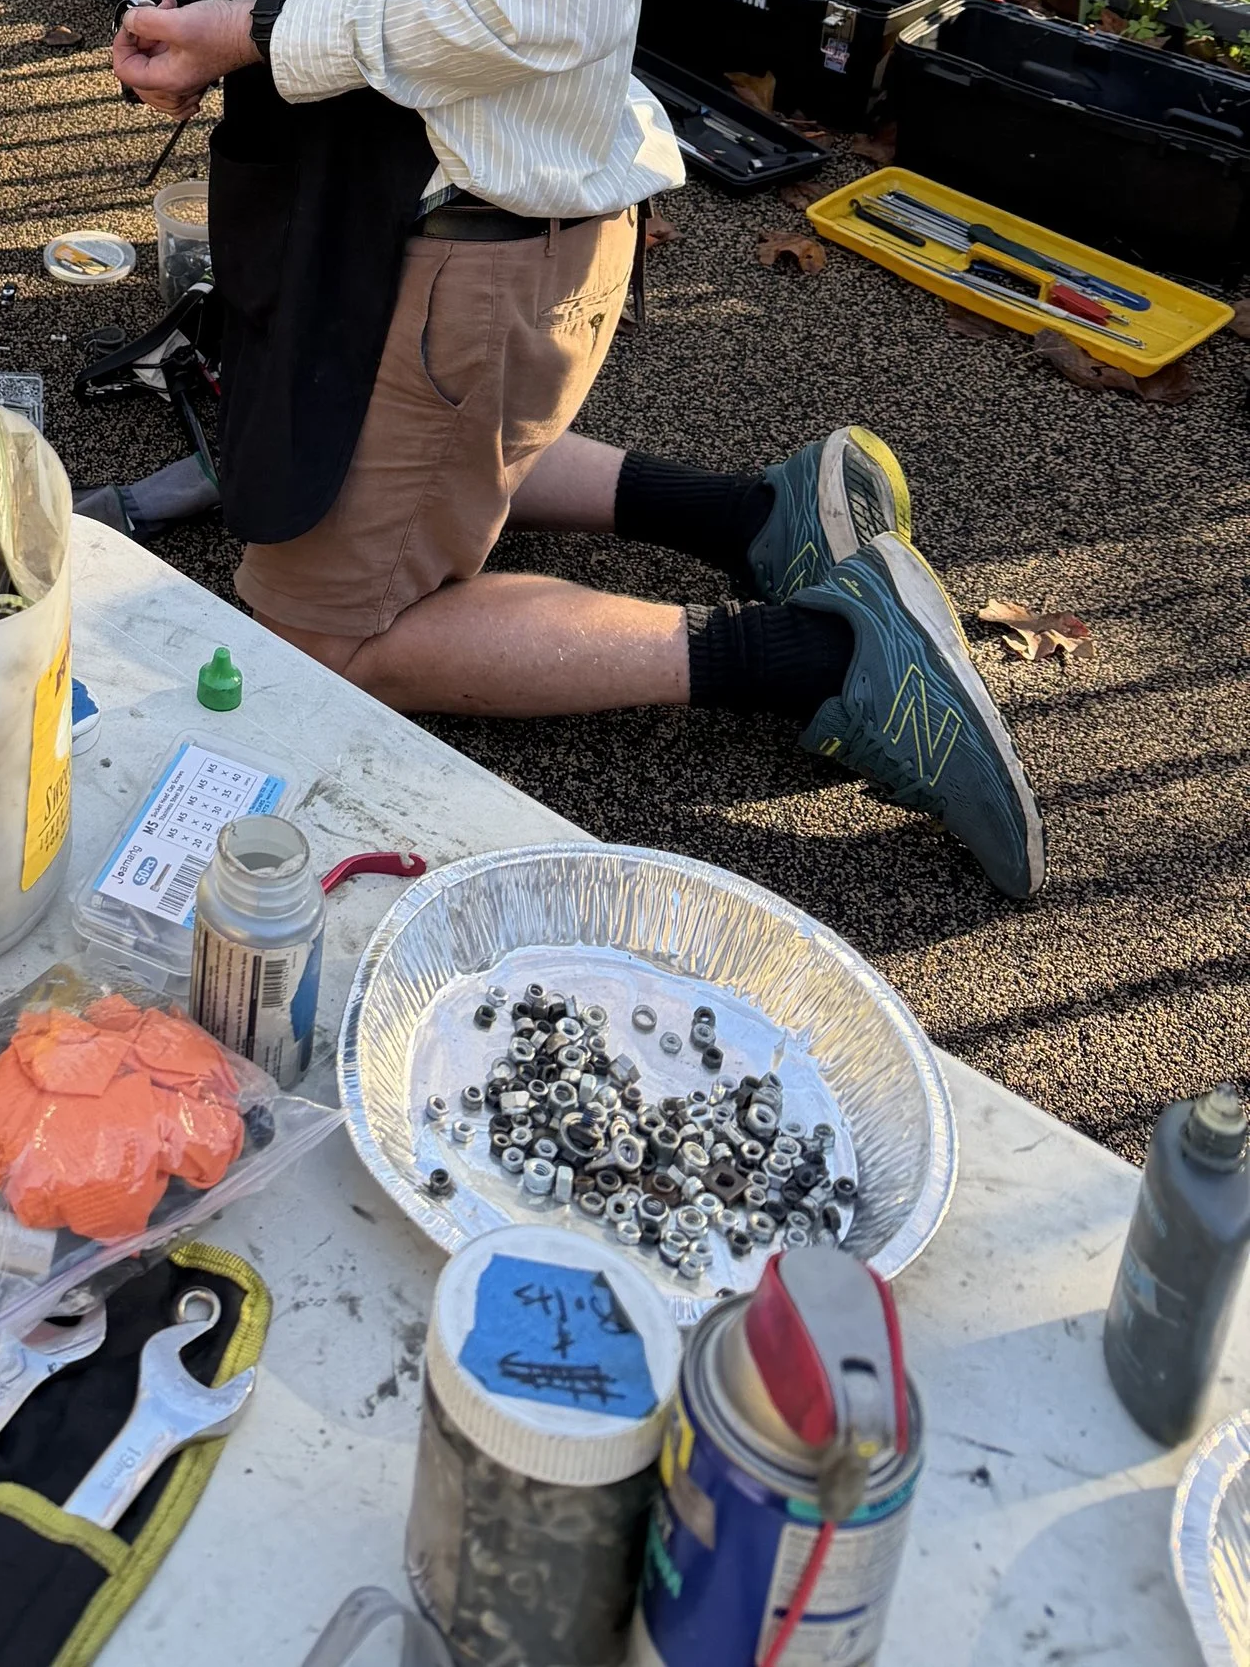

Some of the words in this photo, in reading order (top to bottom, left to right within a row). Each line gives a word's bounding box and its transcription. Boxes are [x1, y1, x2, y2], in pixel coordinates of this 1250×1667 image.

[142, 819, 159, 836] M5
[192, 839, 203, 849] 20
[202, 822, 213, 832] 25
[211, 806, 222, 816] 30
[222, 789, 232, 799] 35
[232, 773, 242, 782] 40
